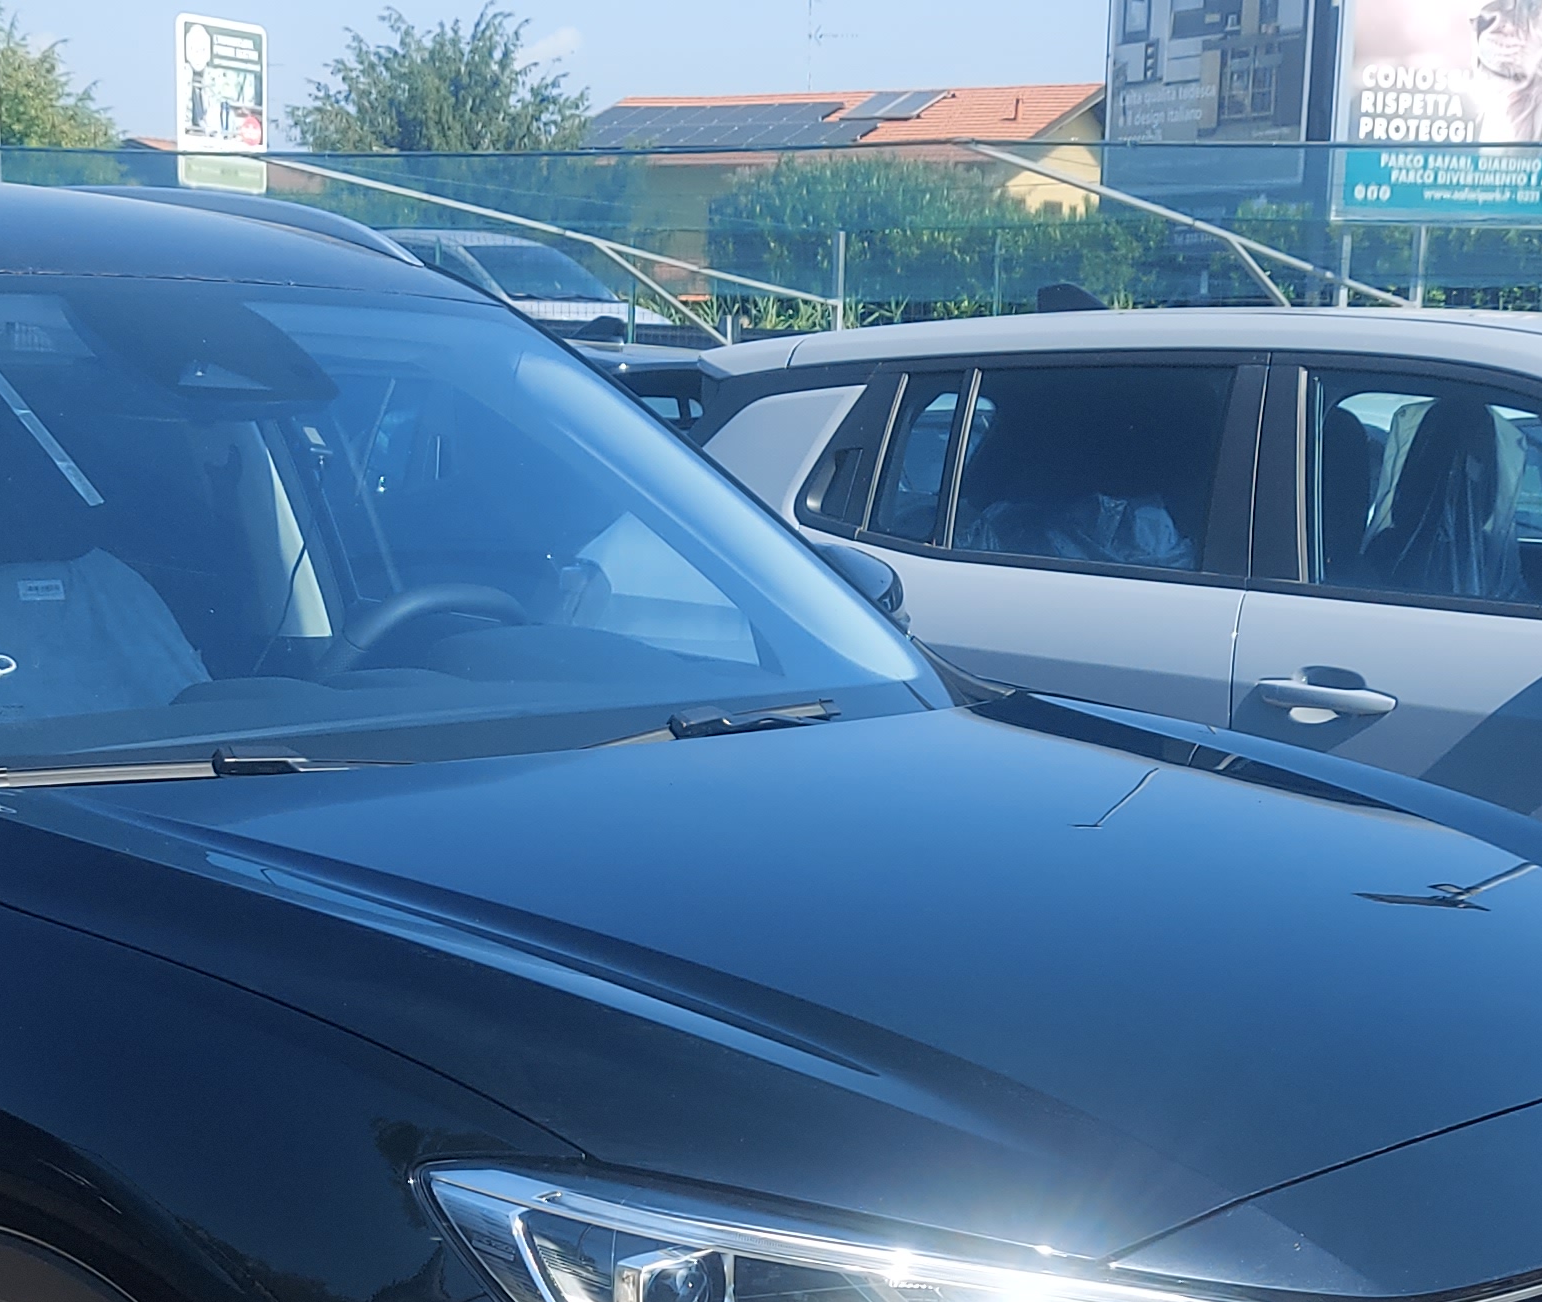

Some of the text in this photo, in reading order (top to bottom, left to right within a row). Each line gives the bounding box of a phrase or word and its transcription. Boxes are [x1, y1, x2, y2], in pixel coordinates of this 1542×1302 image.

[1361, 91, 1463, 117] RISPETTA
[1134, 109, 1163, 128] design
[1166, 107, 1203, 123] italiano
[1359, 116, 1475, 143] PROTEGGI
[1381, 152, 1424, 168] PARCO
[1427, 154, 1474, 171] SAFARI,
[1478, 156, 1542, 172] GIARDINO
[1391, 169, 1435, 184] PARCO
[1437, 170, 1528, 187] DIVERTIMENTO
